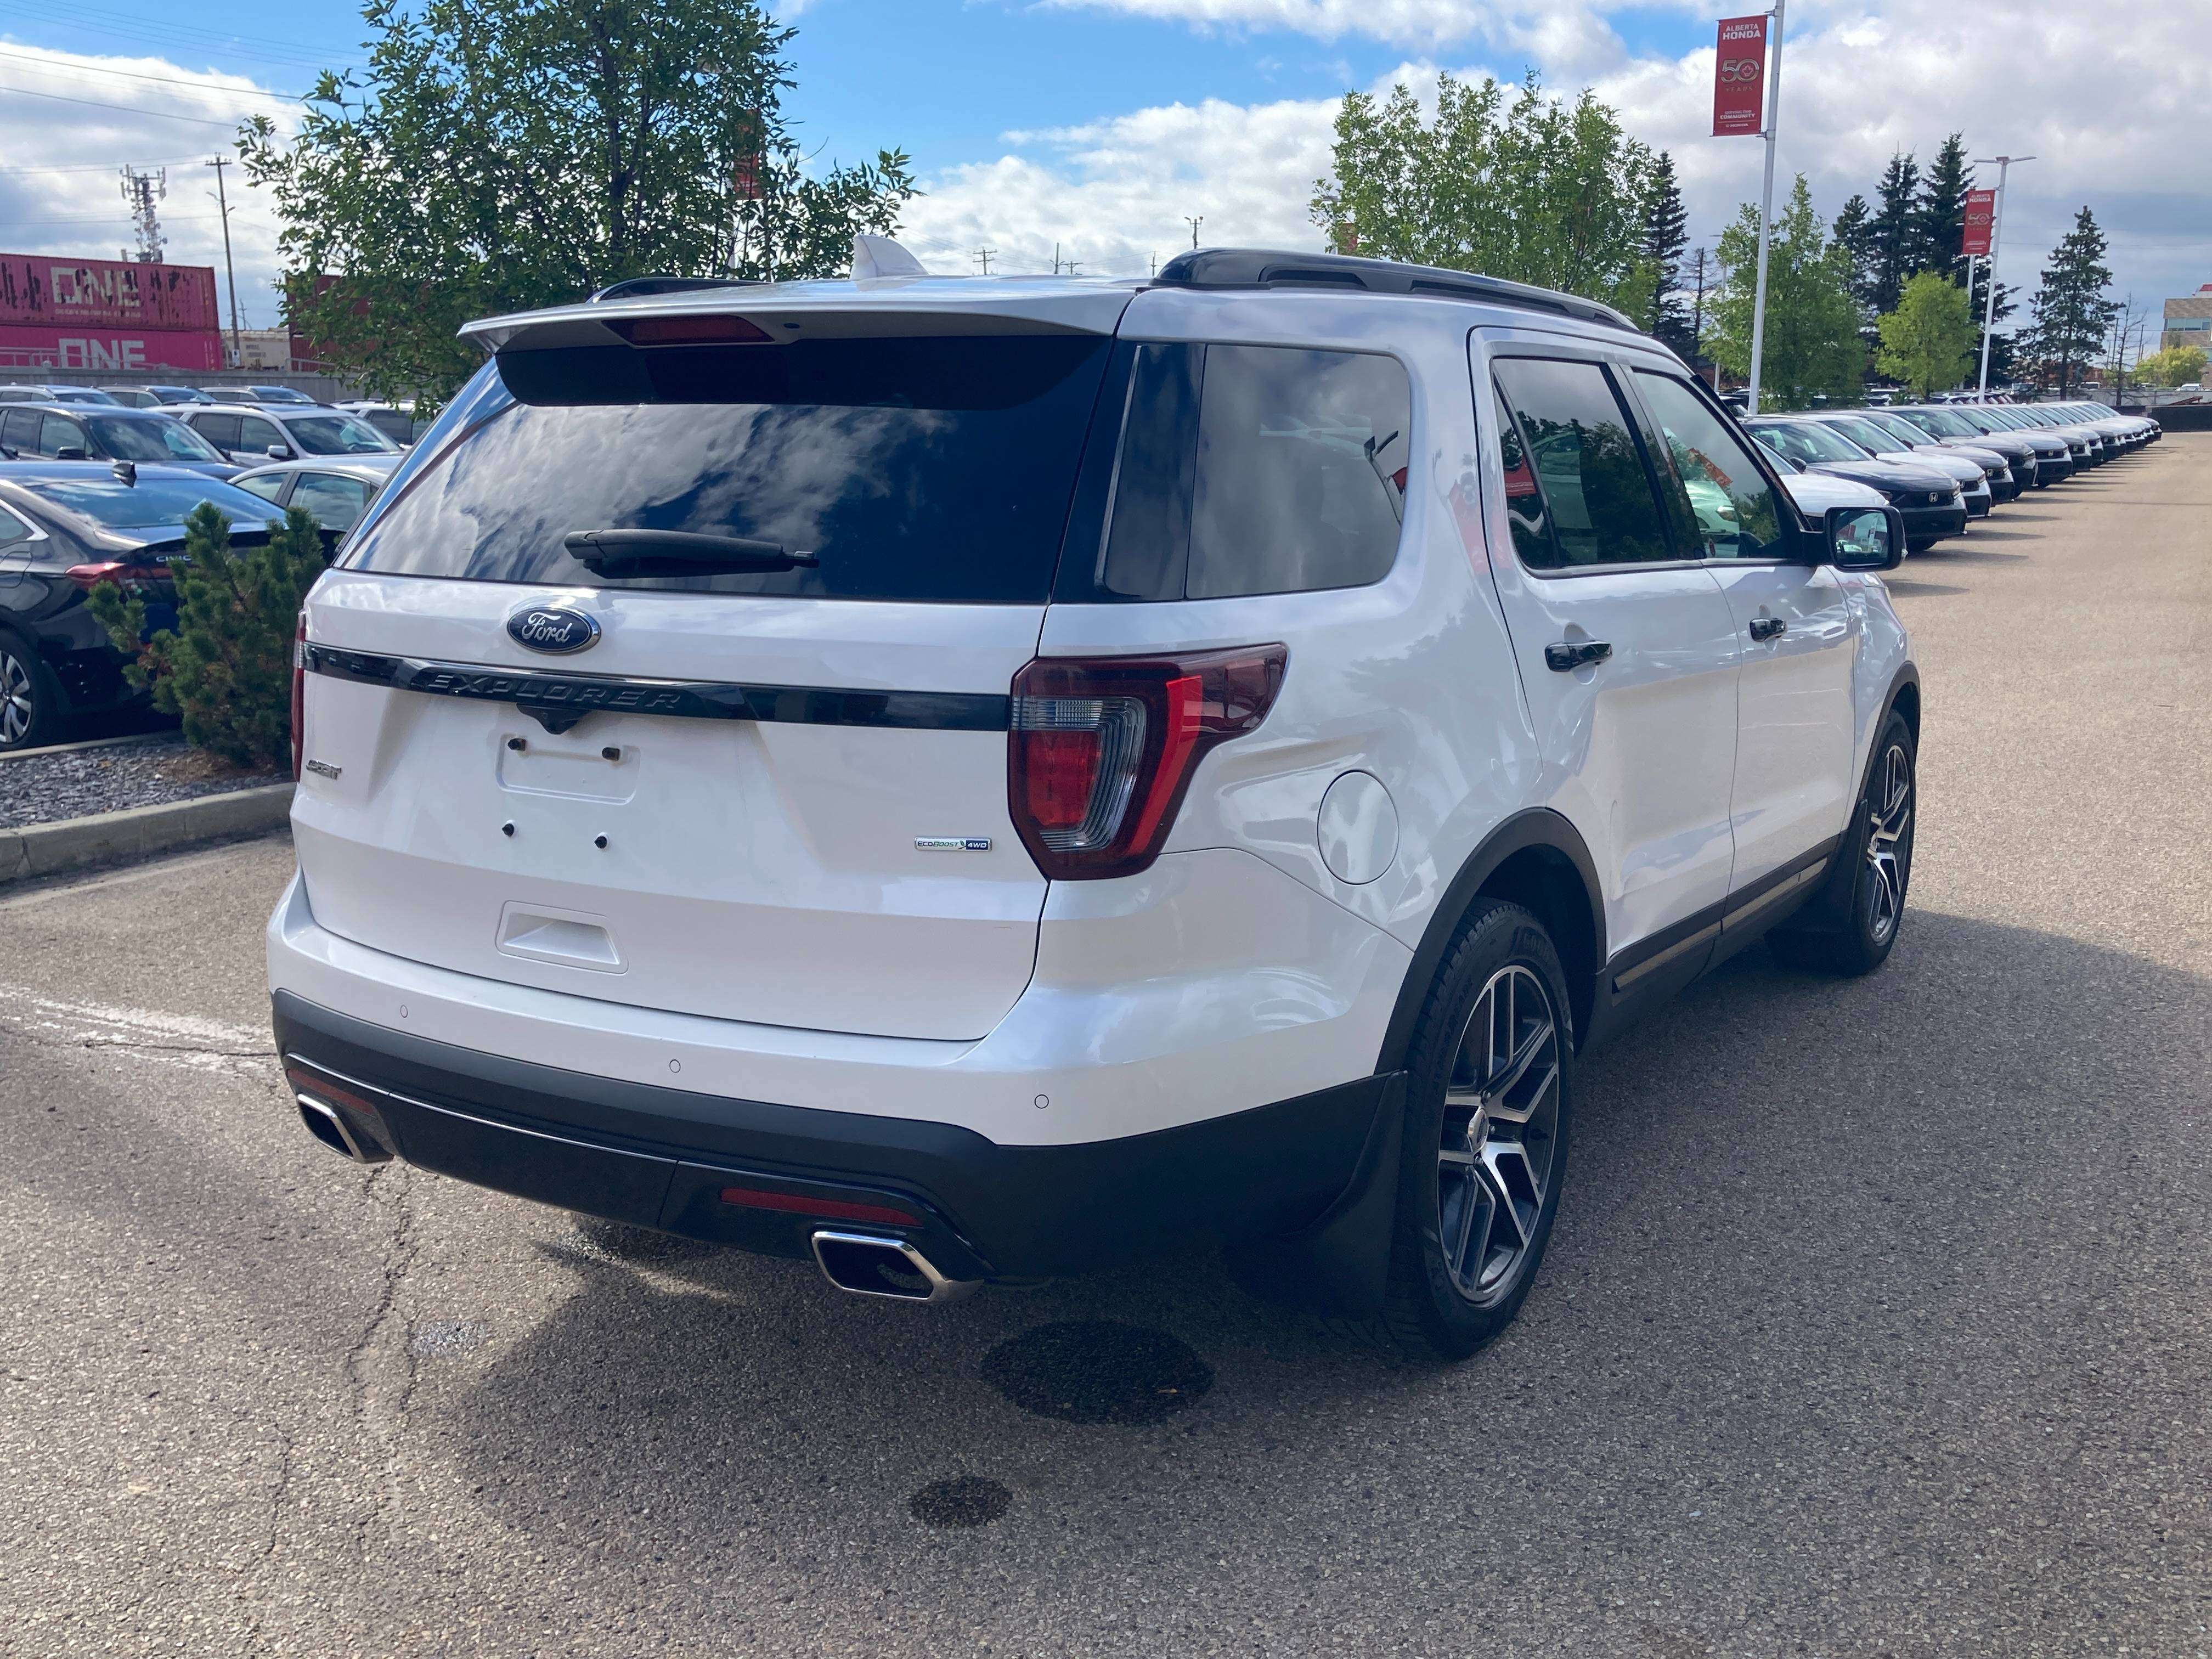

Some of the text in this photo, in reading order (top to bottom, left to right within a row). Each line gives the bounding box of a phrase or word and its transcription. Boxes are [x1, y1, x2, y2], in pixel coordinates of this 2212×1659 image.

[1722, 30, 1761, 40] HONDA
[1725, 23, 1758, 32] ALBERTA
[1720, 58, 1760, 83] 50
[50, 267, 140, 307] ONE
[58, 337, 146, 370] ONE
[521, 612, 573, 643] Ford
[428, 673, 681, 709] EXPLORER
